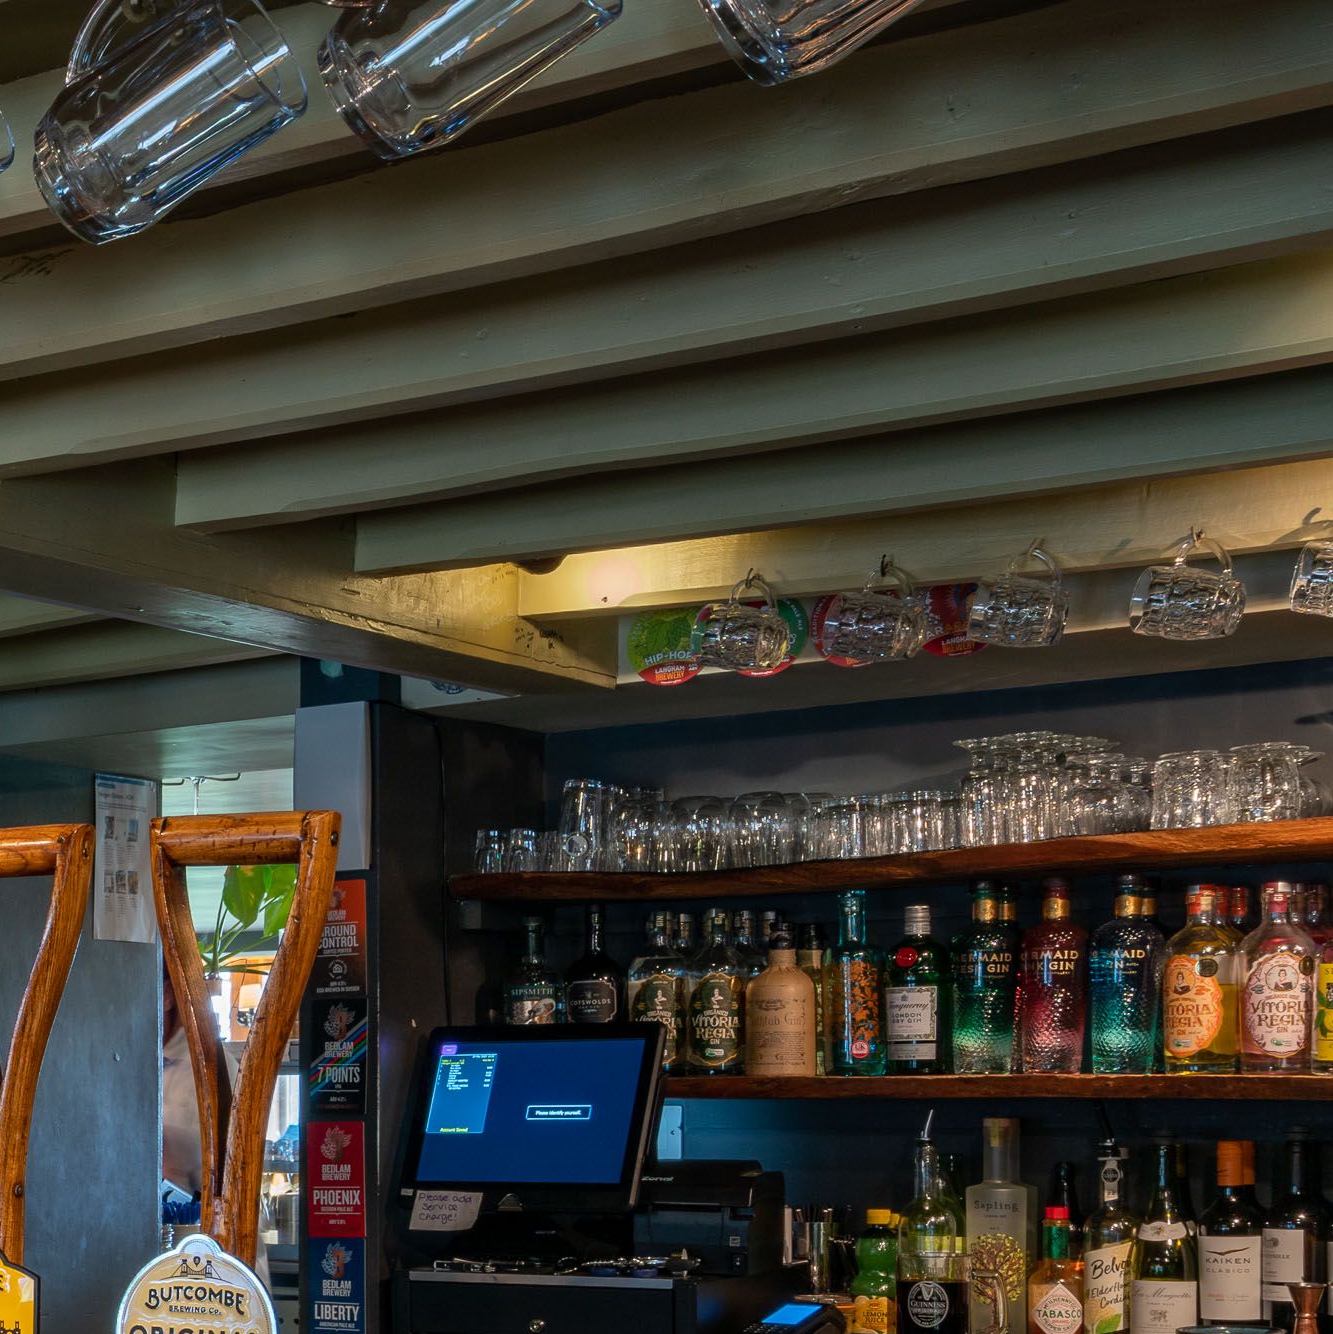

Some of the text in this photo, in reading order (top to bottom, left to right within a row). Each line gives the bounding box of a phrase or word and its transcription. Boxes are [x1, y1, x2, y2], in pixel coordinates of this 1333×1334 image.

[654, 664, 685, 673] LANGHAM
[655, 672, 685, 682] BREWERY
[986, 963, 1010, 973] GIN
[1048, 961, 1075, 971] GIN
[511, 988, 554, 996] SIPSMITH
[569, 998, 612, 1006] COTSWOLDS
[1276, 1026, 1289, 1034] GIN
[324, 1041, 354, 1051] BEDLAM
[854, 1043, 866, 1051] UK
[324, 1050, 353, 1058] BREWERY
[318, 1066, 360, 1084] 7 POINTS
[321, 1164, 352, 1174] BEDLAM
[321, 1173, 351, 1182] BREWERY
[313, 1189, 361, 1206] PHOENIX
[418, 1192, 450, 1203] Please
[452, 1193, 473, 1204] add
[973, 1200, 1020, 1213] Sapling
[322, 1279, 352, 1289] BEDLAM
[322, 1288, 351, 1297] BREWERY
[144, 1285, 246, 1316] BUTCOMBE
[910, 1300, 946, 1308] GUINNESS
[168, 1305, 206, 1315] BREWING
[314, 1303, 360, 1321] LIBERTY
[862, 1310, 888, 1319] LEMON
[1036, 1309, 1082, 1319] TABASCO
[1042, 1317, 1077, 1332] PEPPER SAUCE
